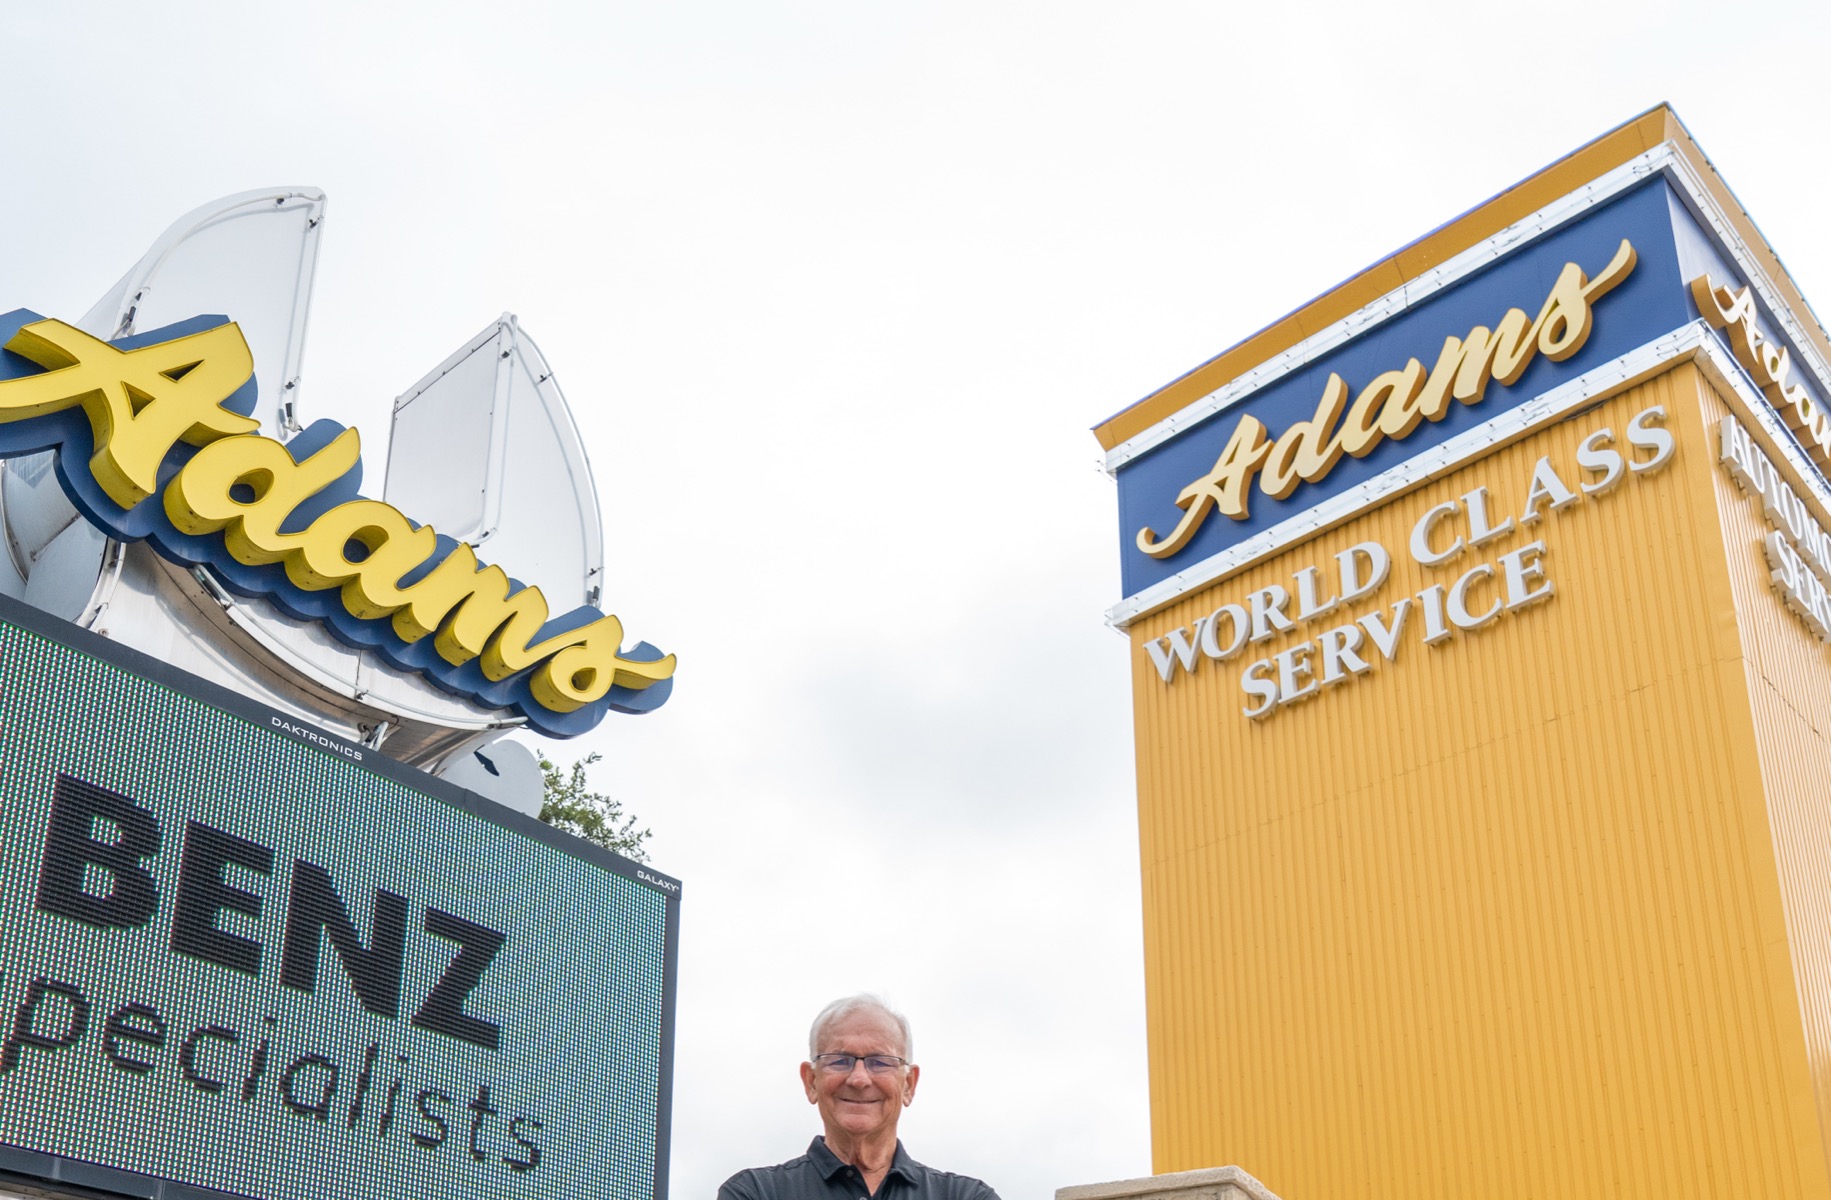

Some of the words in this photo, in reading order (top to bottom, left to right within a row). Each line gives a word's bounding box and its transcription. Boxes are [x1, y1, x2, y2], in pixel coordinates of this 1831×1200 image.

[0, 317, 677, 714] Adams
[1136, 237, 1637, 559] Adams
[1143, 541, 1392, 684] WORLD
[1409, 404, 1676, 567] CLASS
[1240, 540, 1555, 719] SERVICE
[1769, 530, 1831, 635] SER
[271, 716, 363, 761] DAKTRONICS
[35, 773, 507, 1052] BENZ
